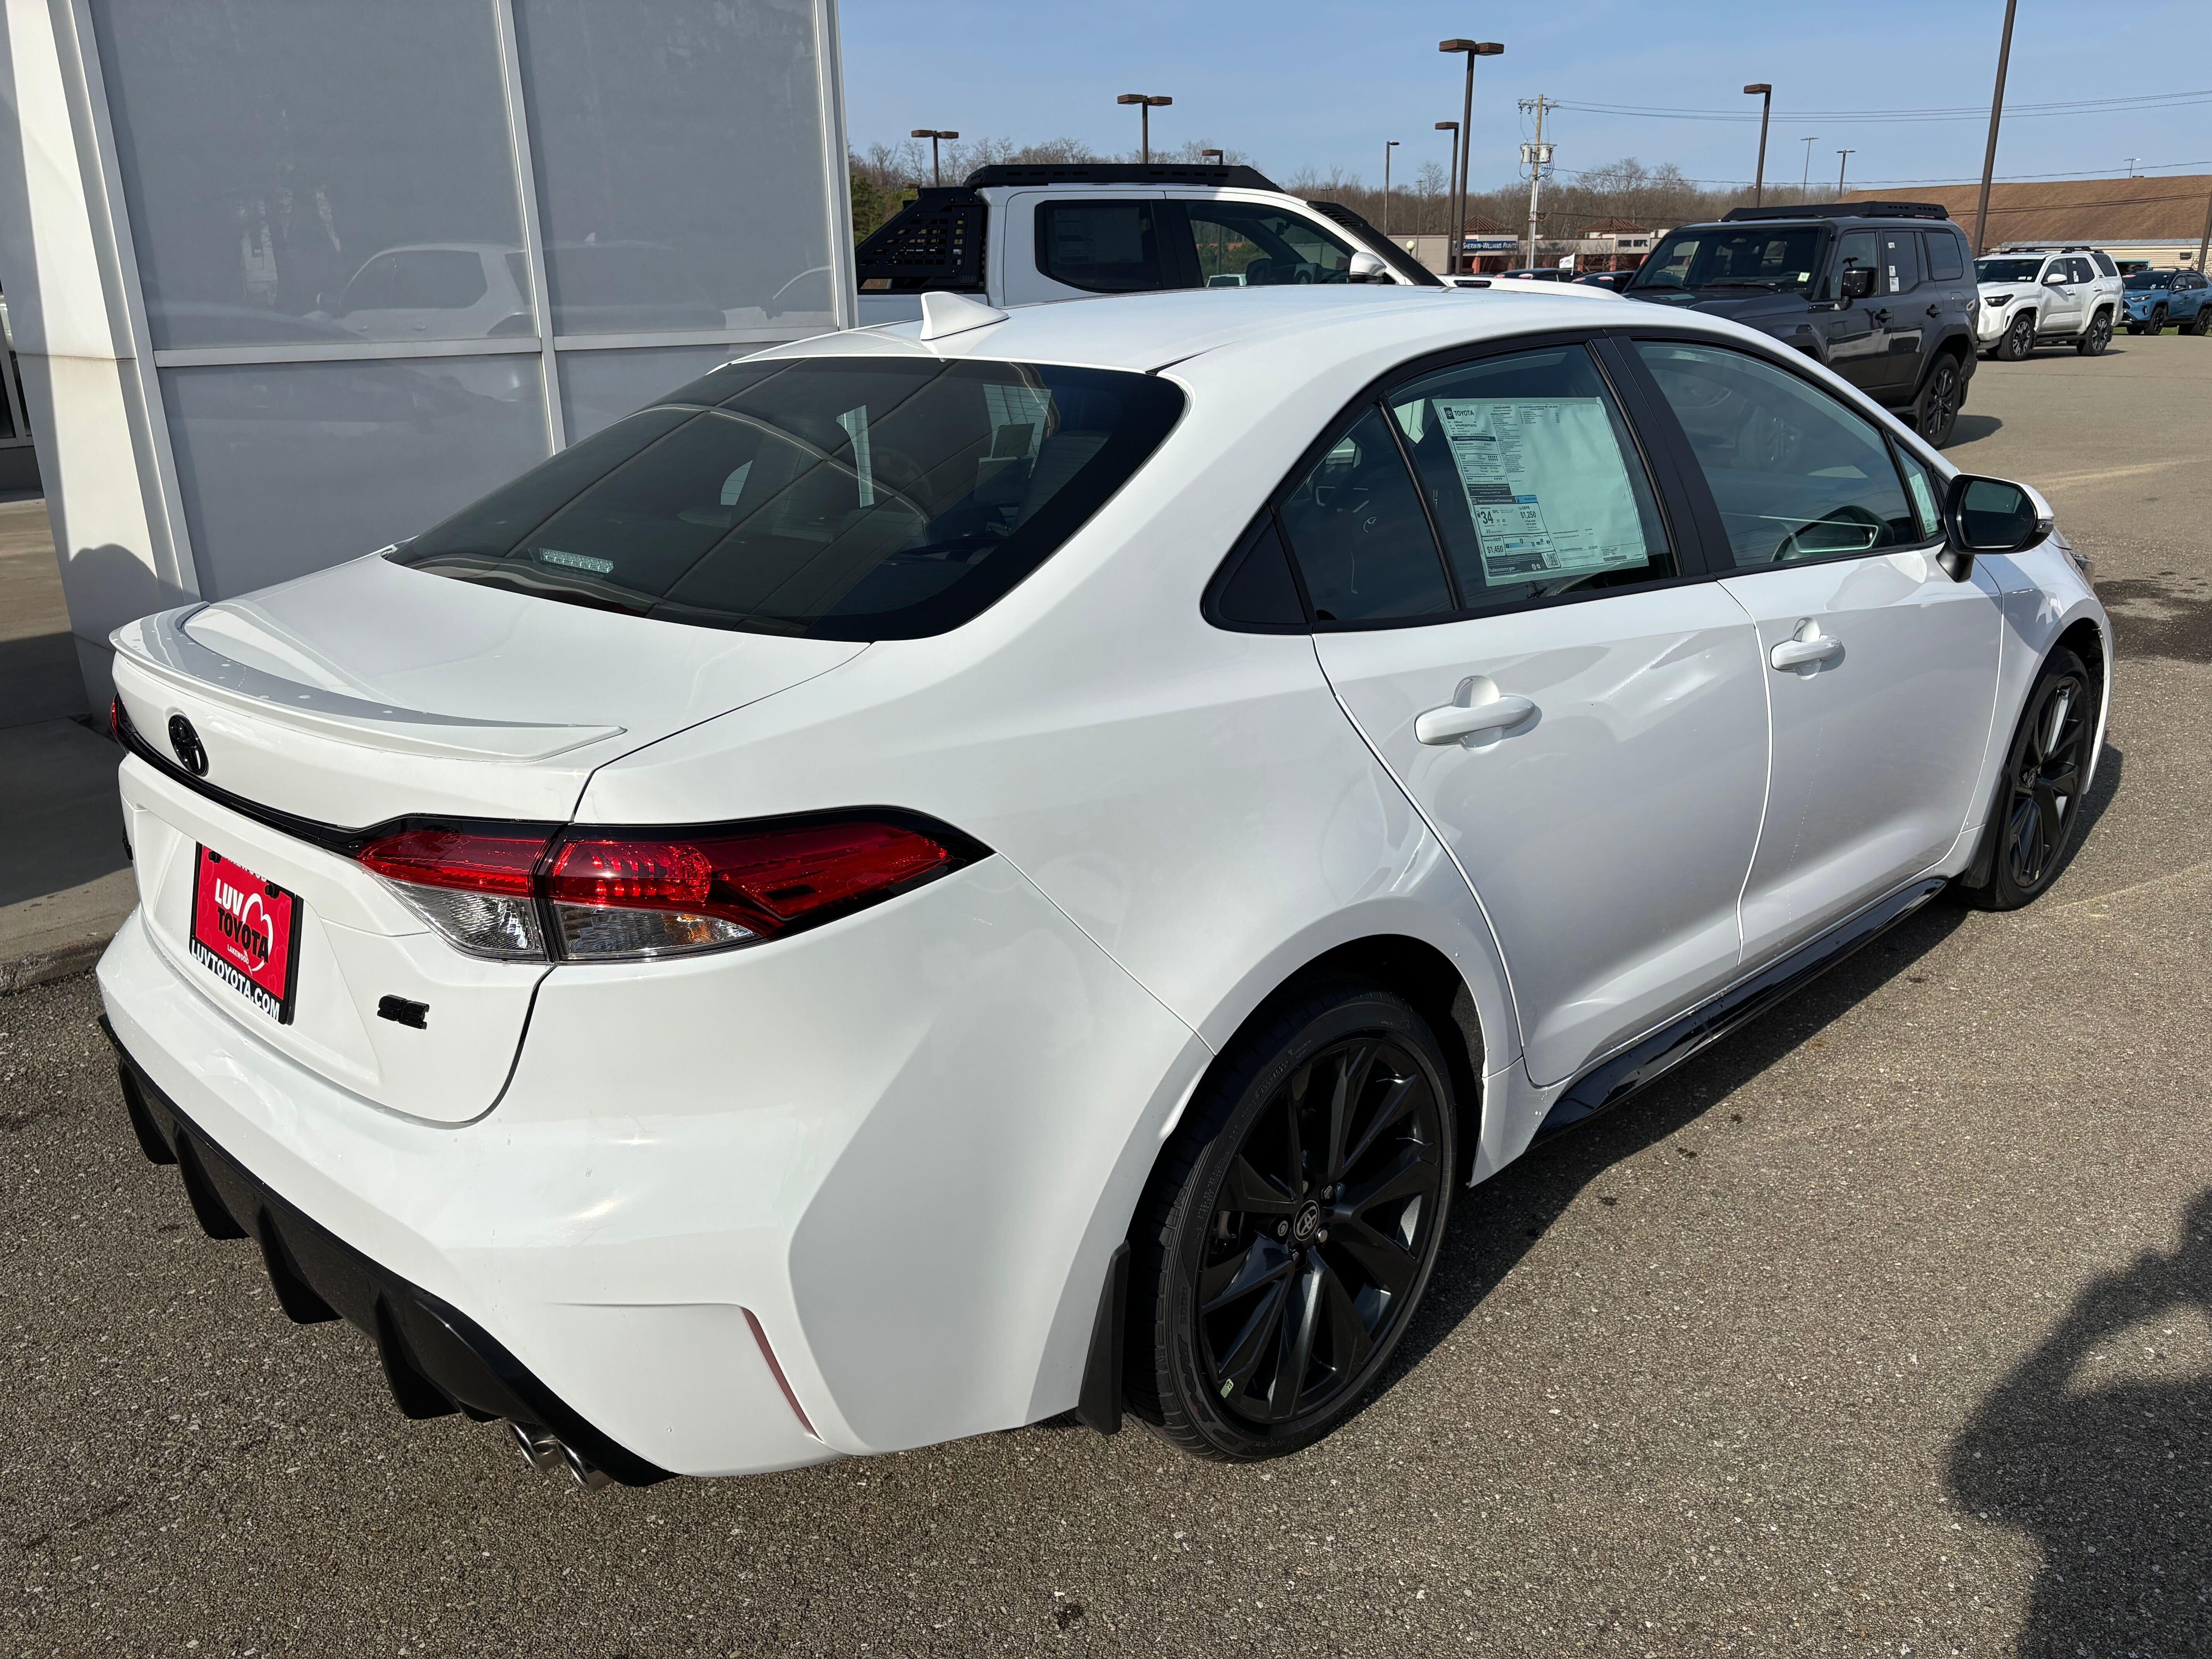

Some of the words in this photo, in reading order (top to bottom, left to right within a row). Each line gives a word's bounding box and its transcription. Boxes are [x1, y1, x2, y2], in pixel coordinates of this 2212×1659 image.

[1480, 511, 1494, 524] 34
[1487, 546, 1503, 554] $1,450
[215, 877, 244, 917] LUV
[218, 905, 269, 964] TOYOTA
[227, 944, 249, 965] LAKEWOOD
[191, 939, 280, 1022] LUVTOYOTA.COM
